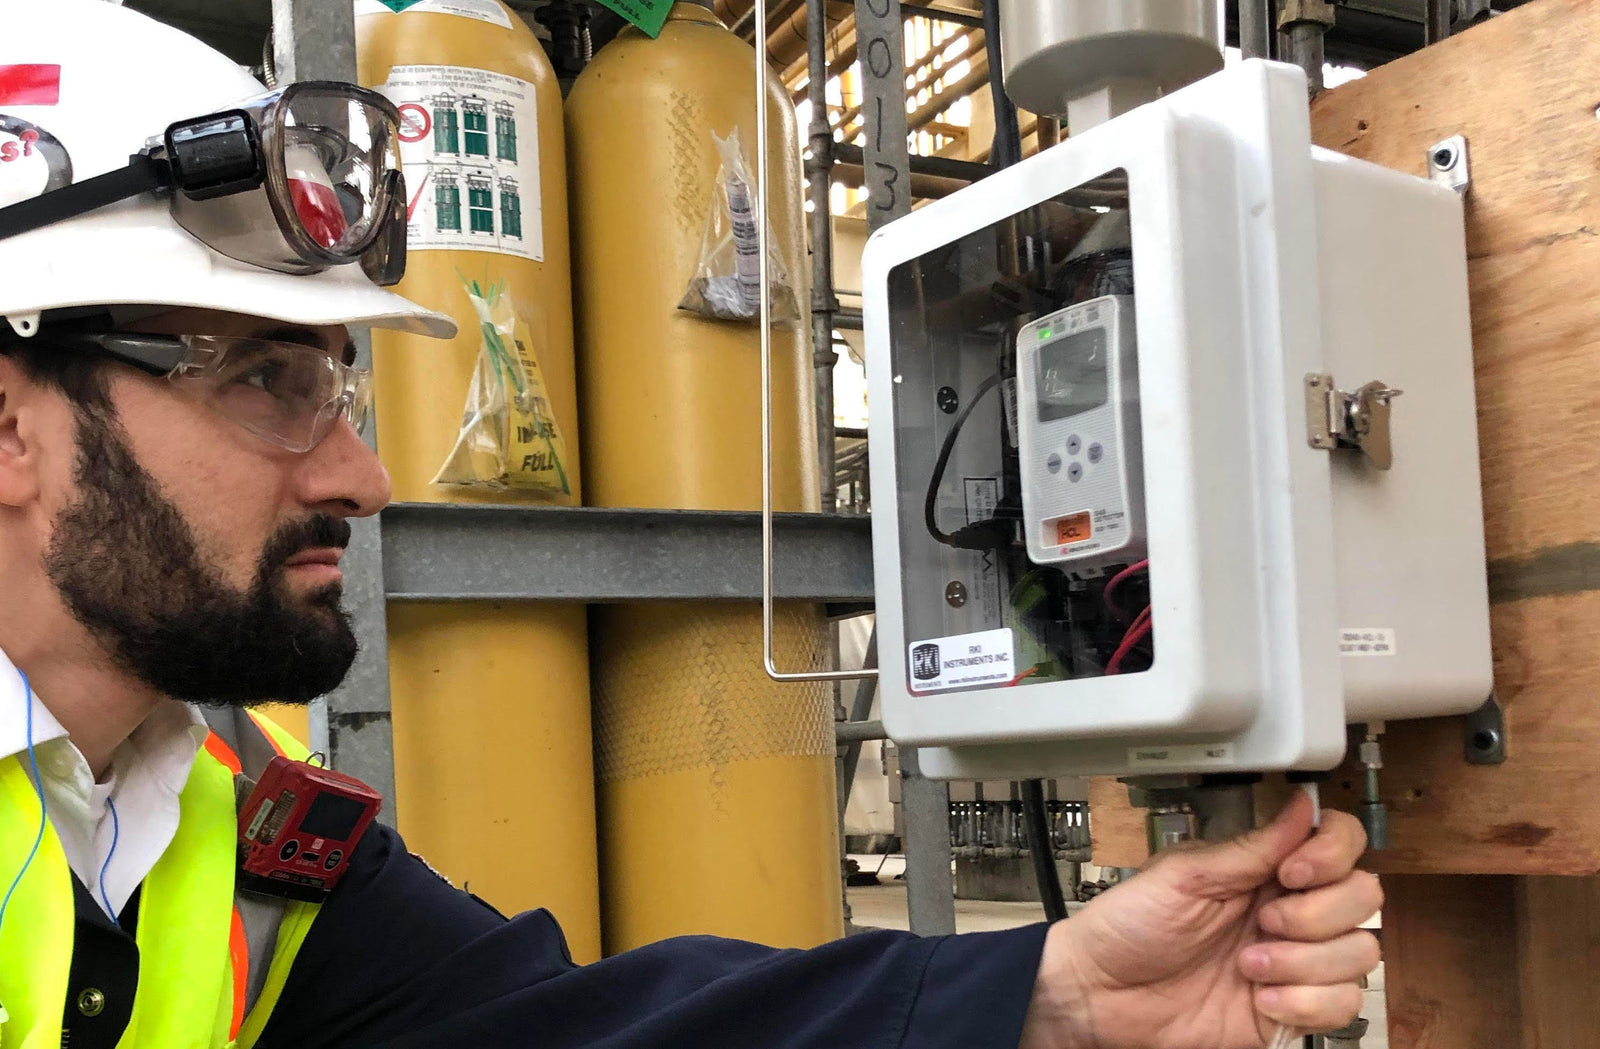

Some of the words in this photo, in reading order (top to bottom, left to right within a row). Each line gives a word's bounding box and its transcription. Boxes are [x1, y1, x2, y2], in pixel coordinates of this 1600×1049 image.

[0, 129, 39, 163] s?
[968, 645, 982, 654] RKI
[944, 655, 993, 668] INSTRUMENTS
